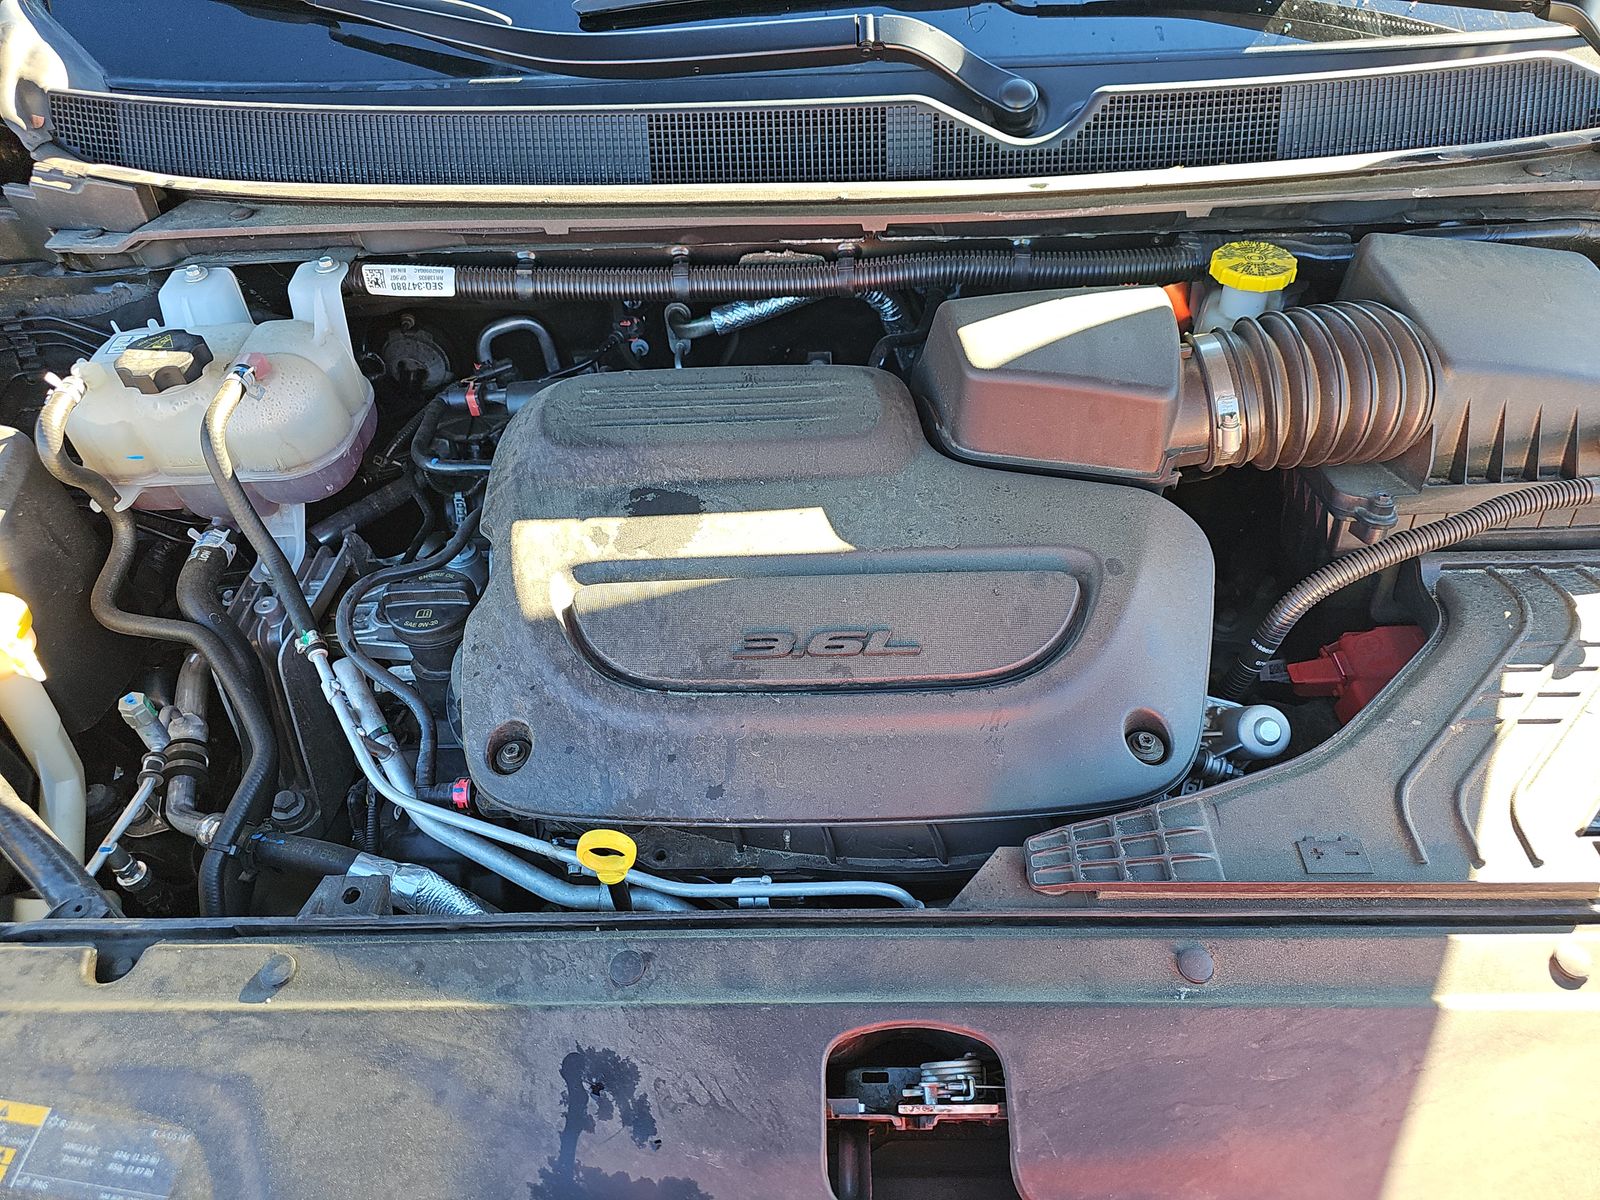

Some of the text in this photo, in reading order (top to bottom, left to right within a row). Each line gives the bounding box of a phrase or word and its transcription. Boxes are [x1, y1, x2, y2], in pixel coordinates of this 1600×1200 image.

[390, 282, 444, 291] SEQ:347880
[418, 572, 445, 581] ENGINE
[403, 619, 439, 628] SAE 0W-20
[733, 628, 922, 660] 3.6L
